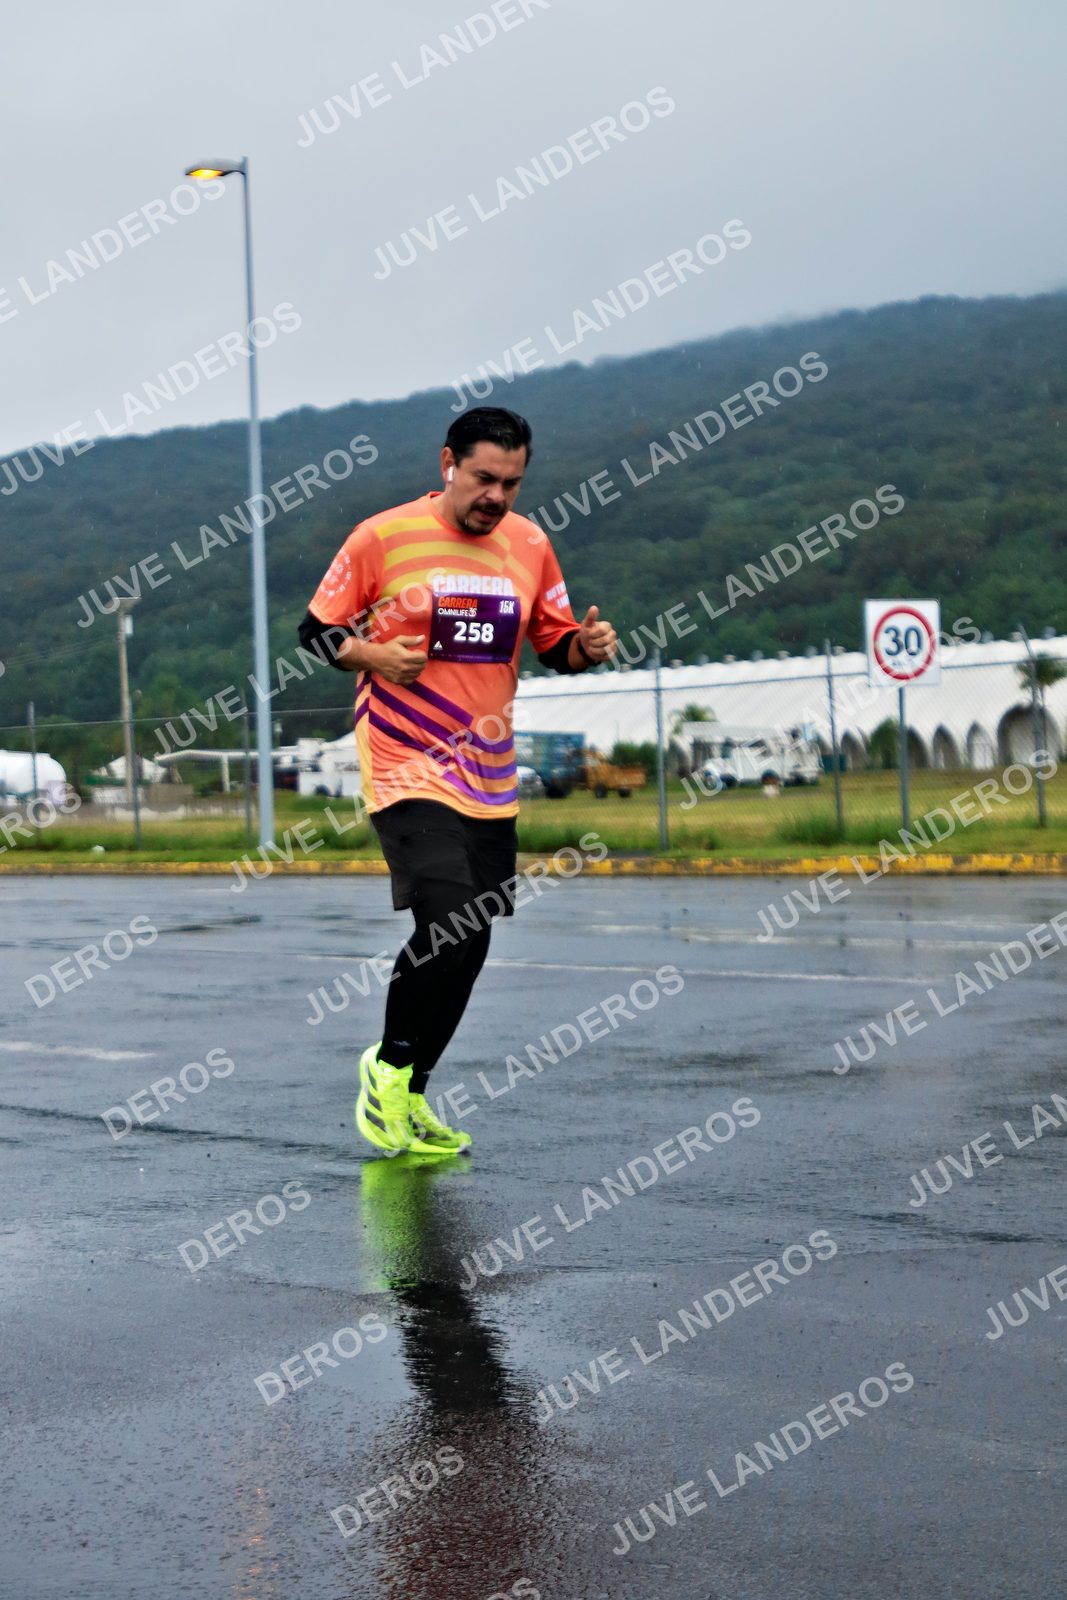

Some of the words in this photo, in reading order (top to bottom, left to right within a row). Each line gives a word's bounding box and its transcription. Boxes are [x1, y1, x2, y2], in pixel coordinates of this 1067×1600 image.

[432, 575, 514, 597] CARRERA
[438, 597, 478, 608] CARRERA
[499, 600, 515, 614] 15K
[454, 621, 494, 643] 258
[884, 626, 922, 656] 30
